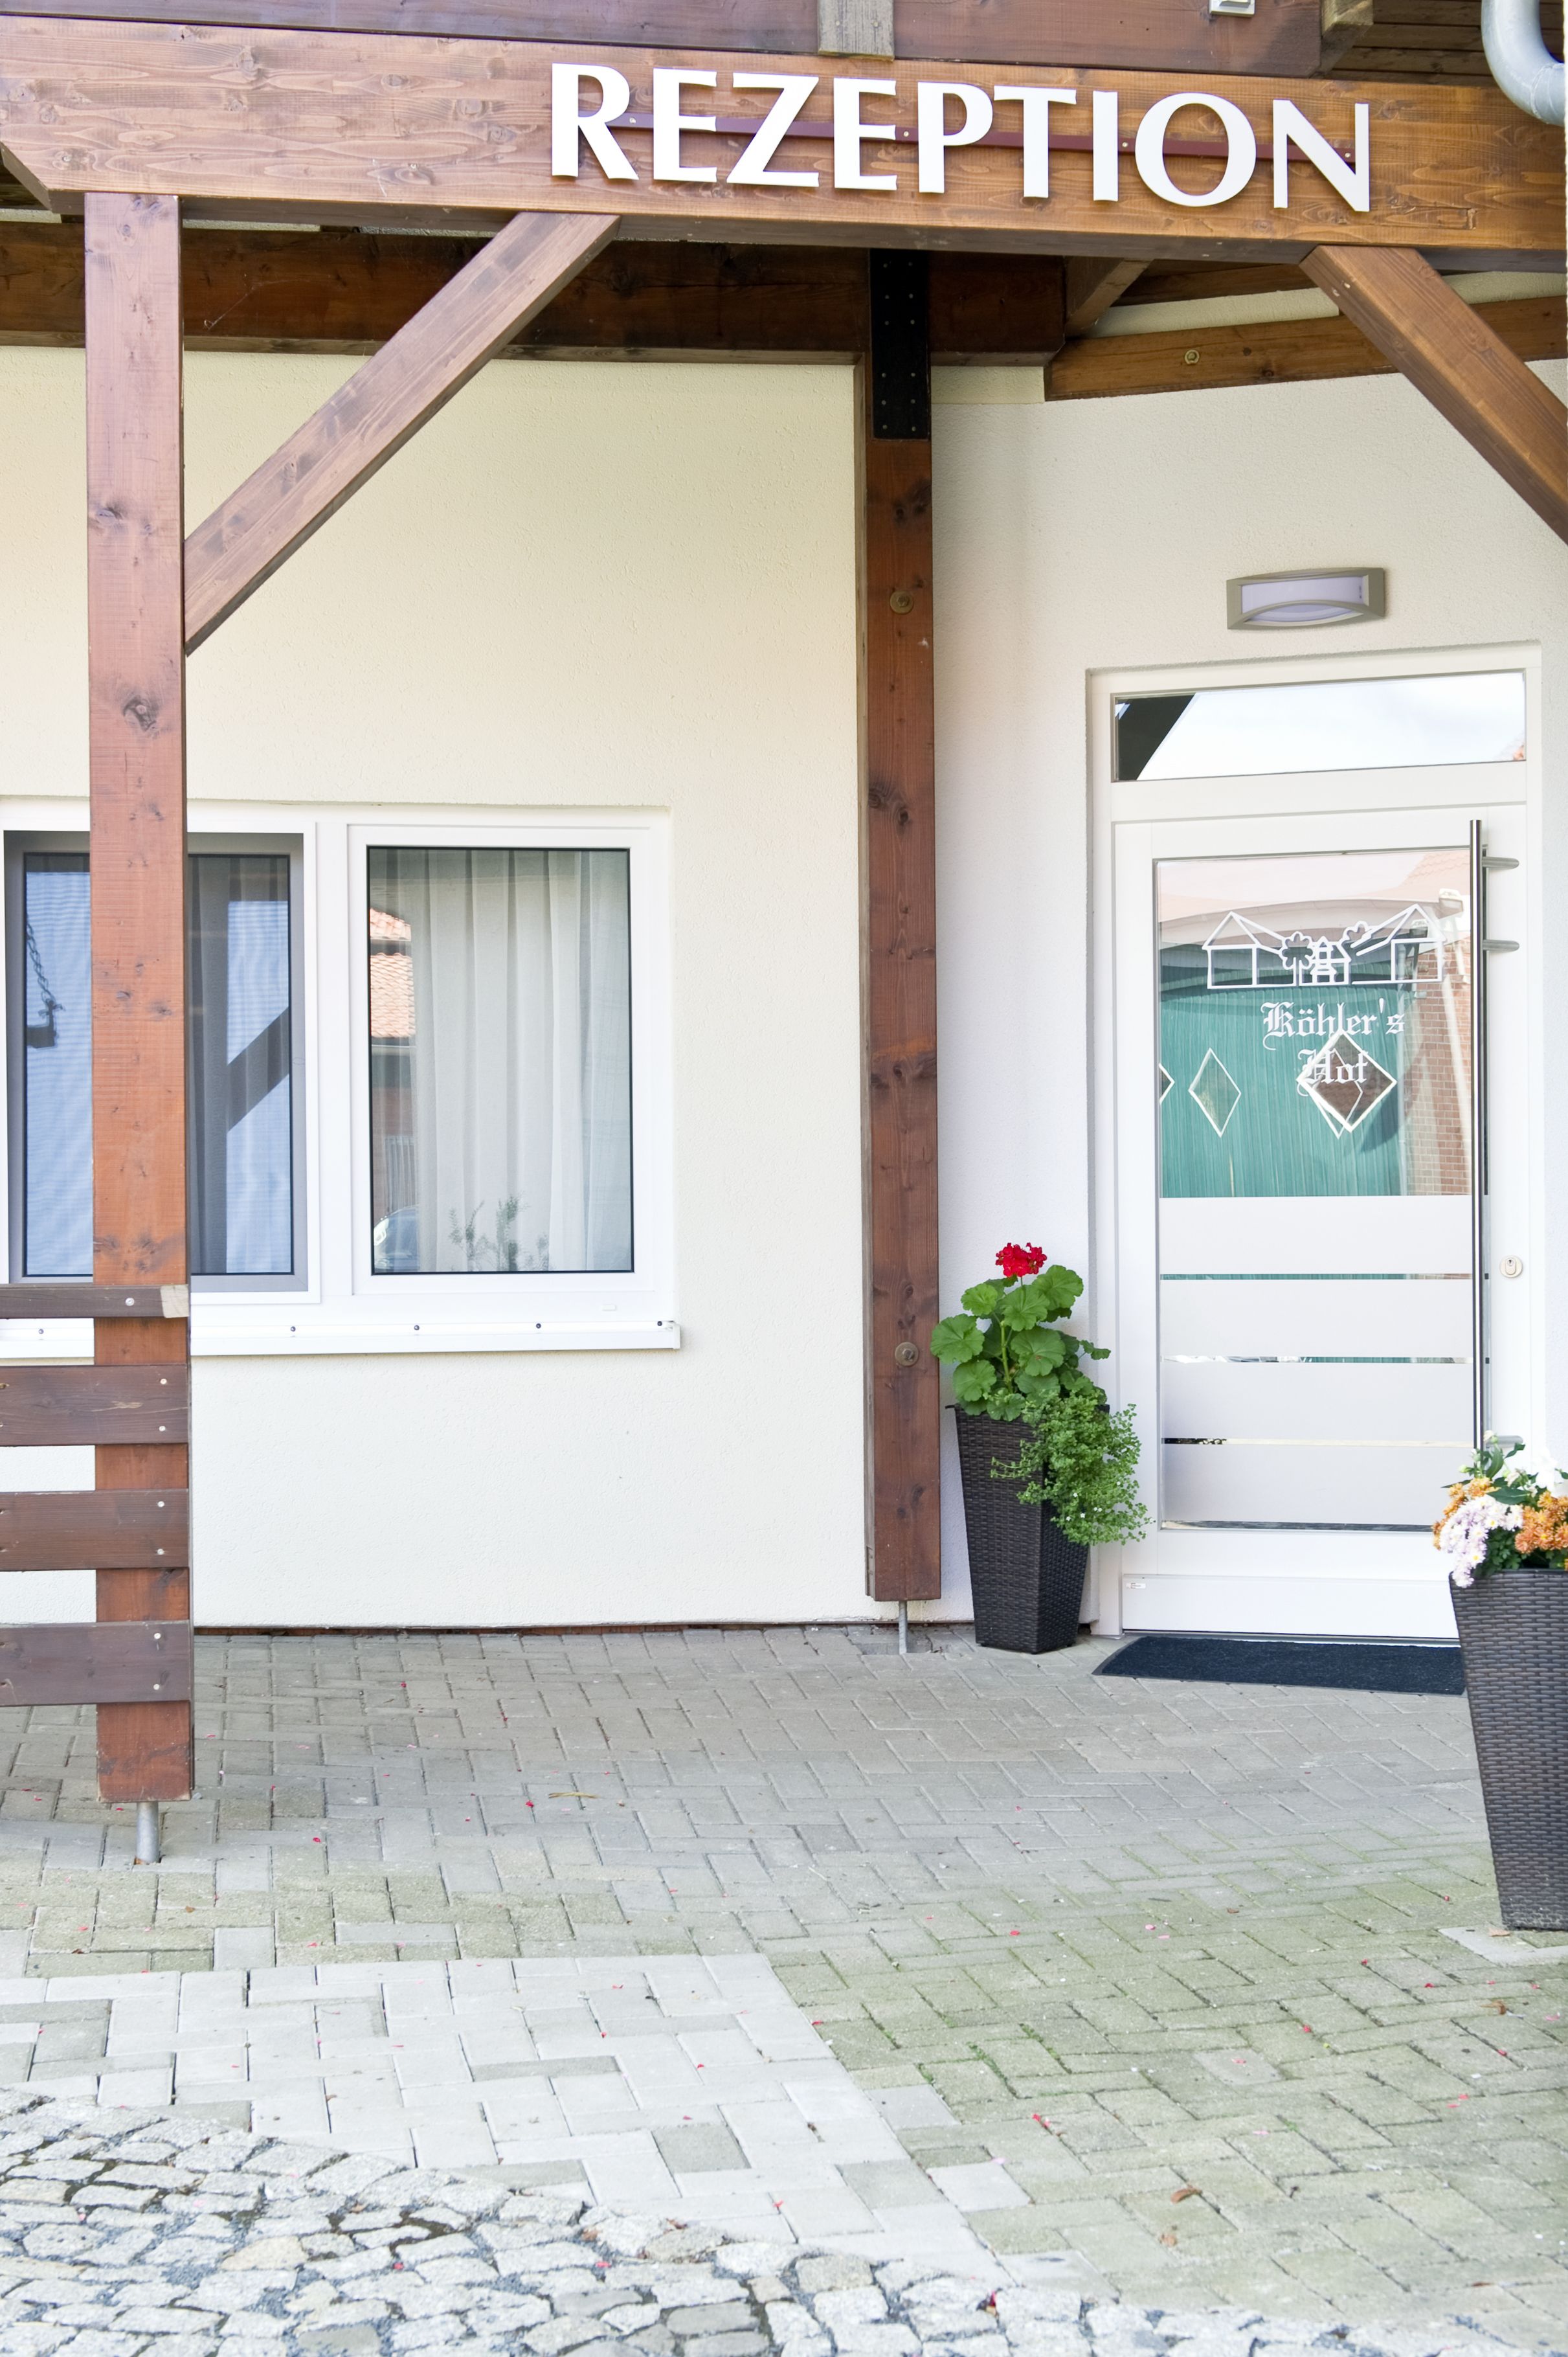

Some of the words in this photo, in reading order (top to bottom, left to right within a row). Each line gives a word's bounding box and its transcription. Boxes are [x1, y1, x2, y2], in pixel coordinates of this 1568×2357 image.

[551, 62, 1371, 212] REZEPTION
[1260, 998, 1405, 1050] Köhler's
[1297, 1048, 1369, 1096] Hof
